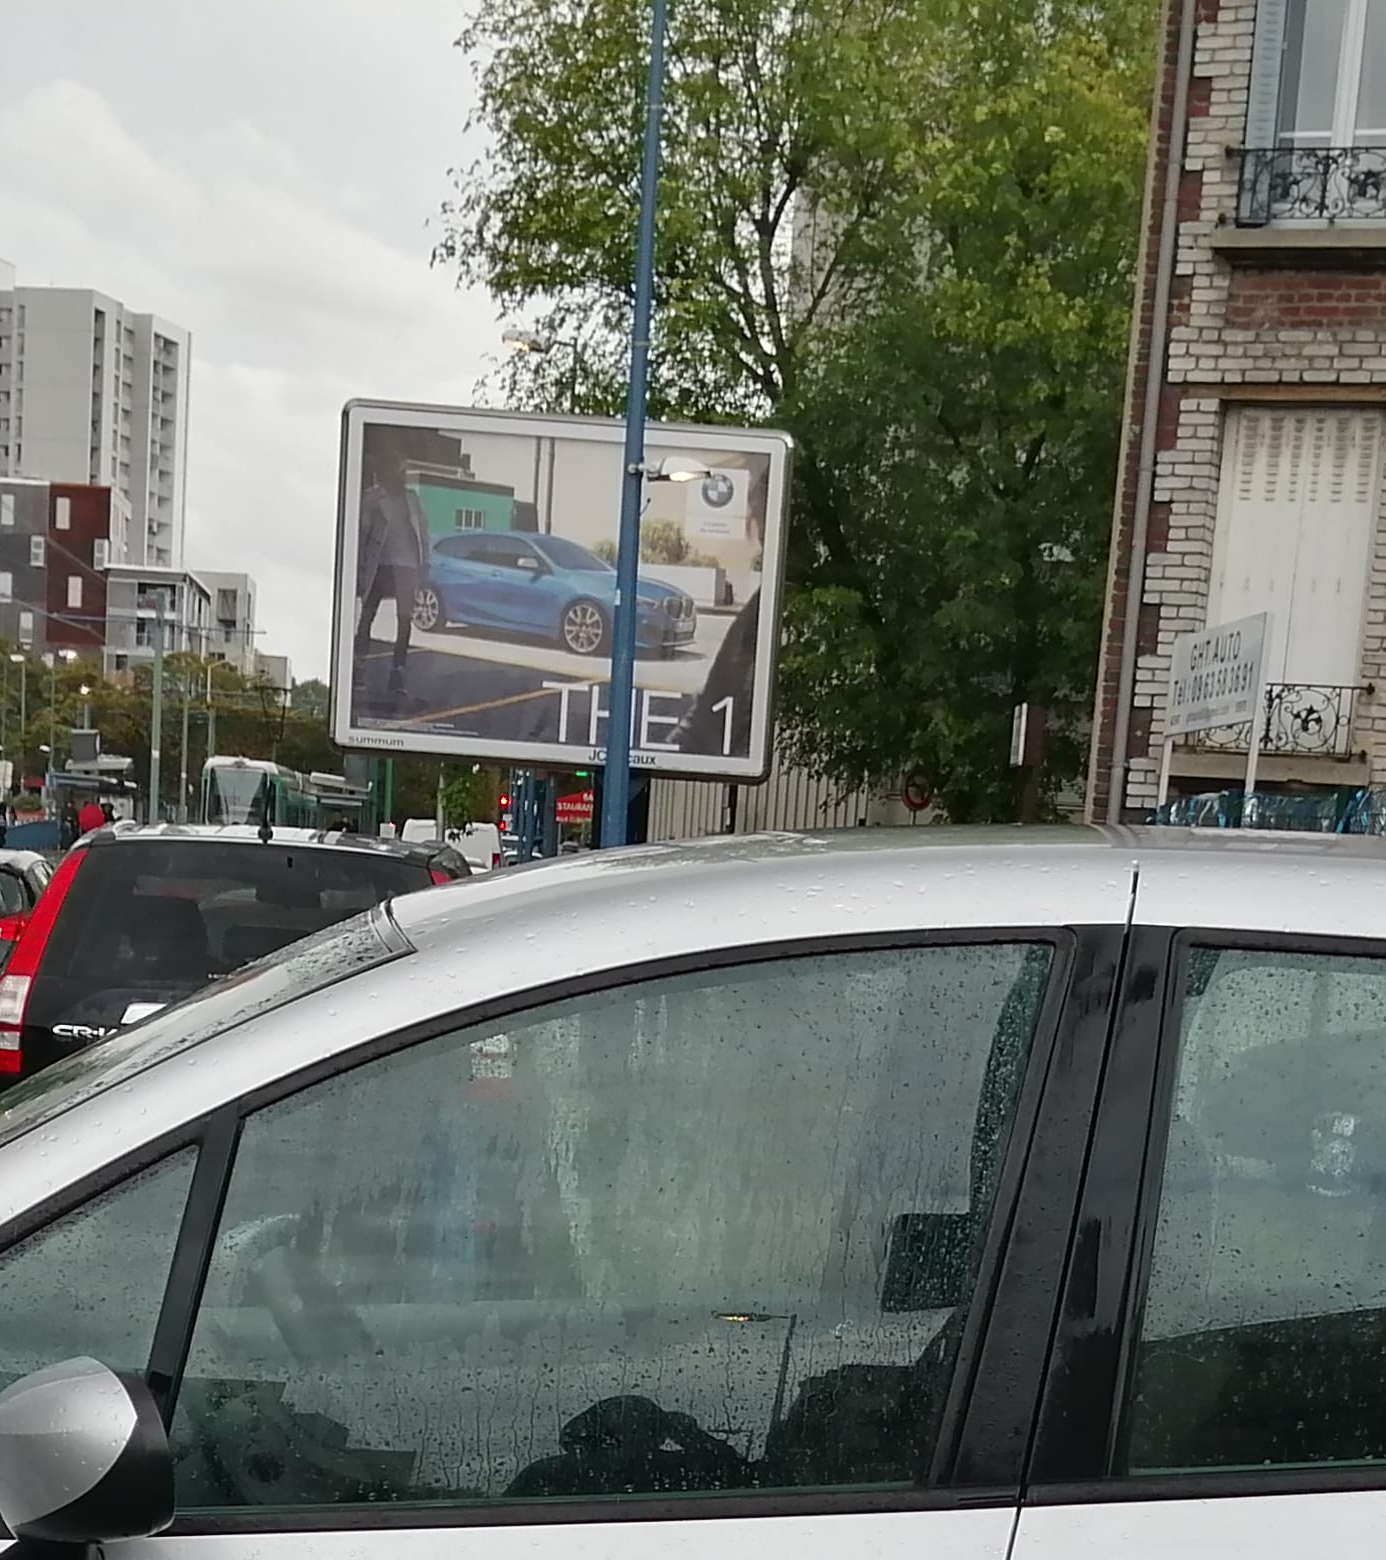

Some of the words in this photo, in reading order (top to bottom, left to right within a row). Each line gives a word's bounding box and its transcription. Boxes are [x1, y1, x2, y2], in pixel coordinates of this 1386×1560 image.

[542, 681, 683, 751] THE
[711, 695, 734, 756] 1
[348, 735, 404, 747] summum
[588, 749, 657, 766] JCaux
